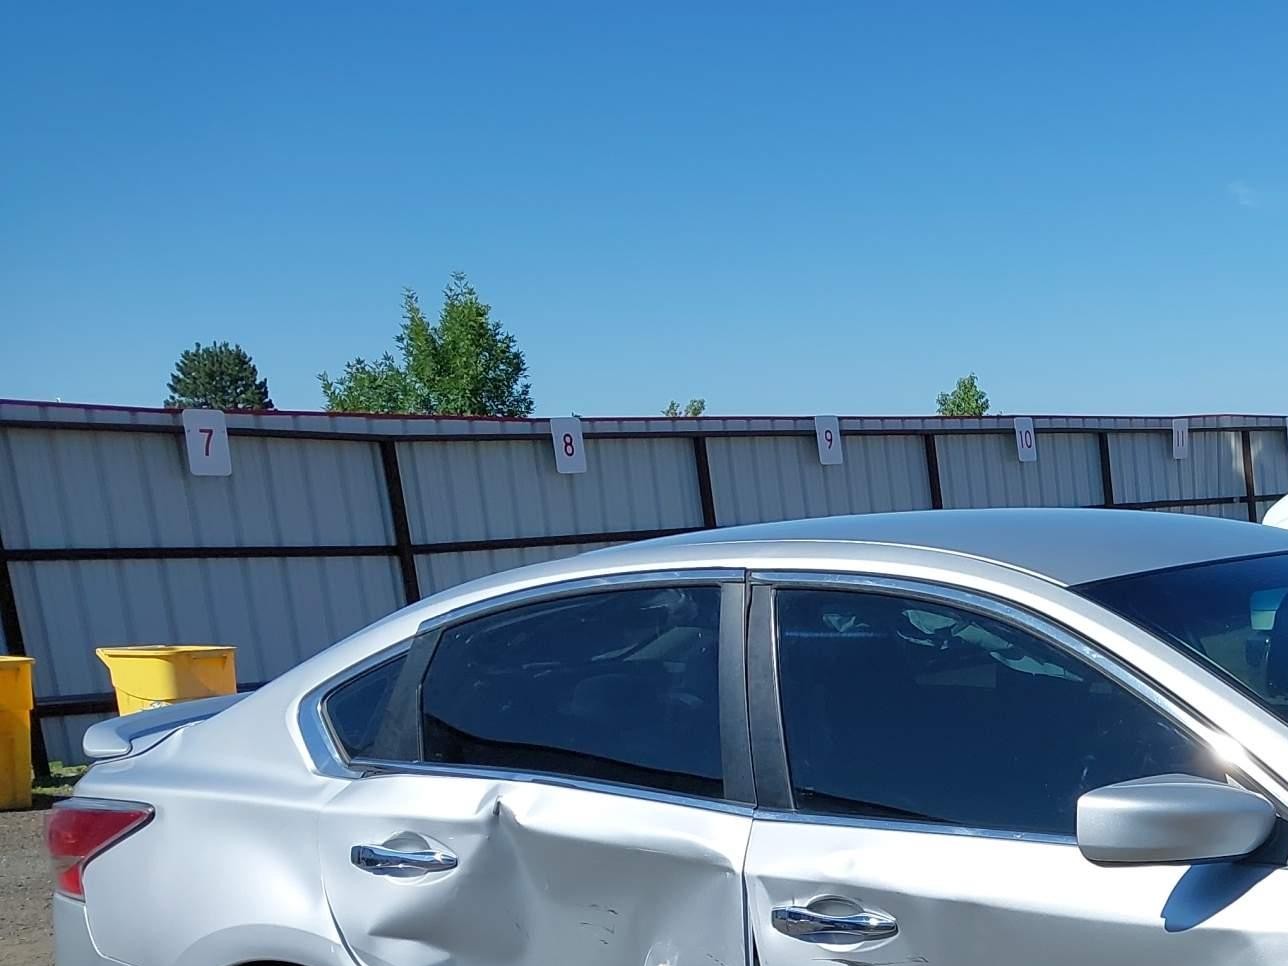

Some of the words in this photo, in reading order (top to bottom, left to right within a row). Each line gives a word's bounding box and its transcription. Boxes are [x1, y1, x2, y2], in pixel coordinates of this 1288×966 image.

[199, 428, 214, 457] 7
[563, 433, 575, 457] 8
[824, 429, 833, 449] 9
[1019, 430, 1032, 449] 10
[1176, 430, 1184, 447] 11
